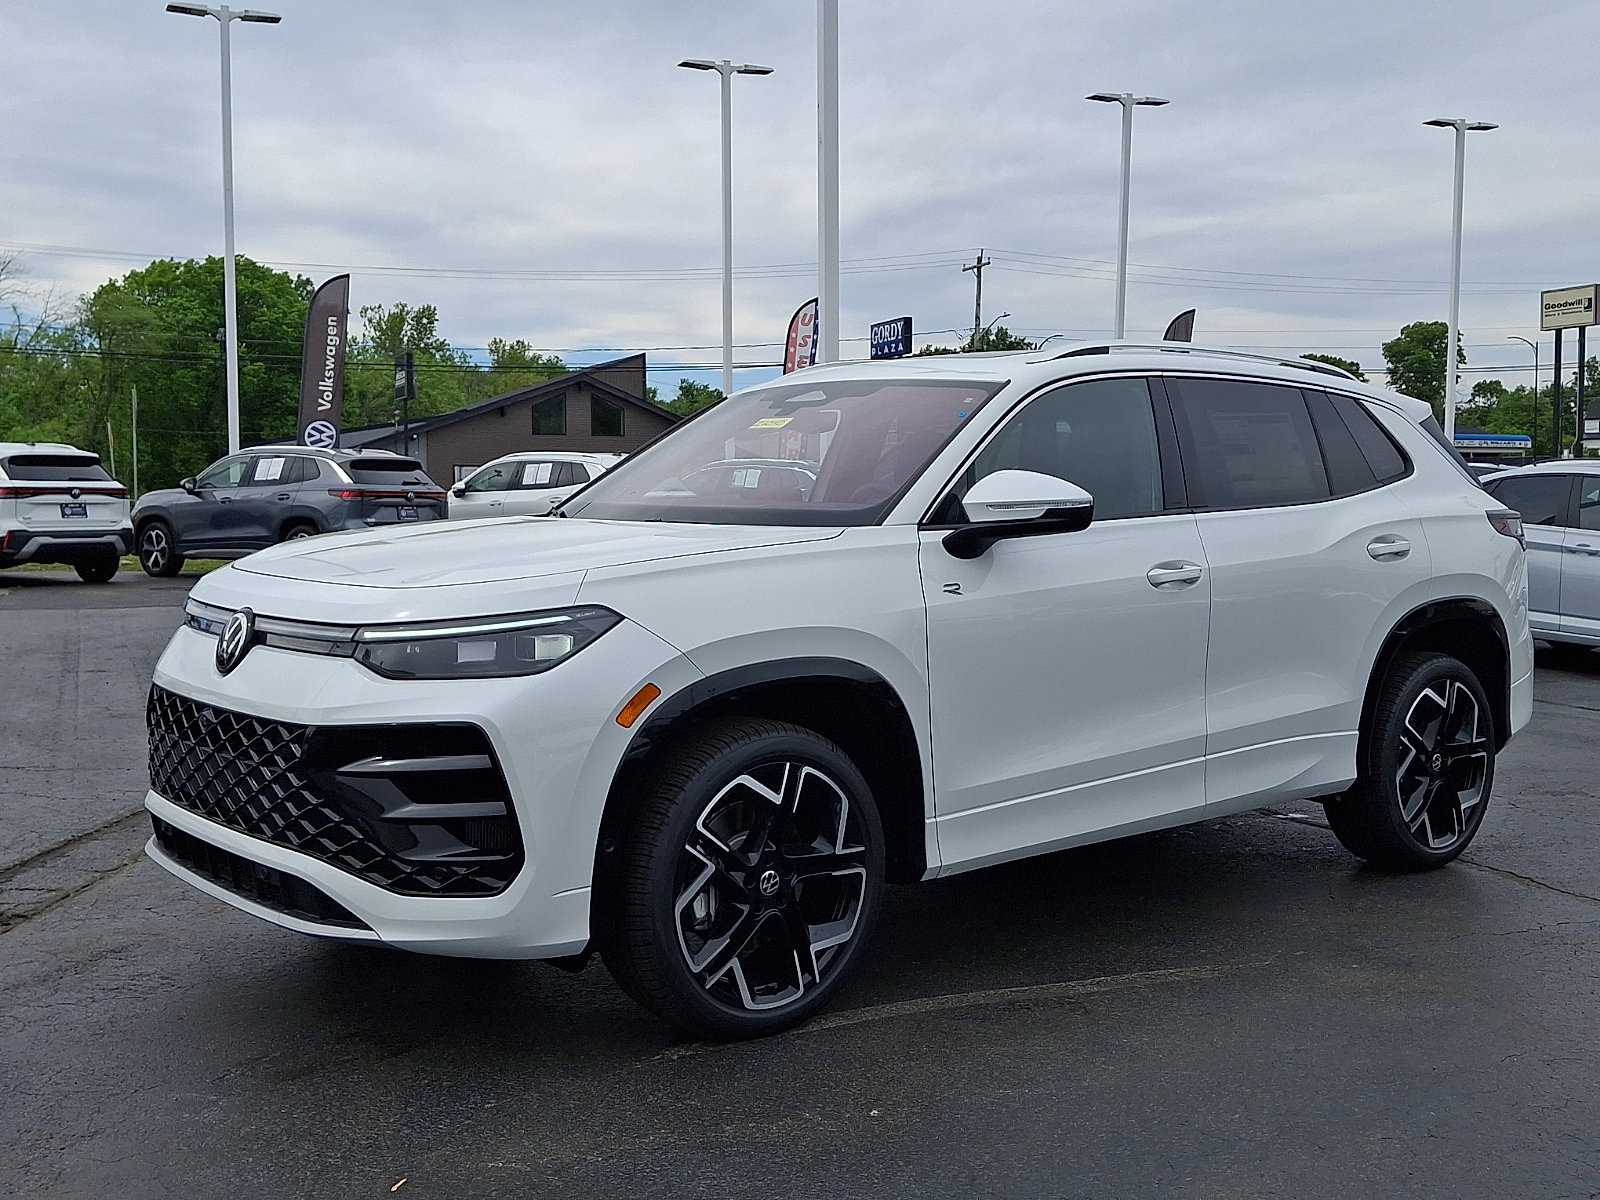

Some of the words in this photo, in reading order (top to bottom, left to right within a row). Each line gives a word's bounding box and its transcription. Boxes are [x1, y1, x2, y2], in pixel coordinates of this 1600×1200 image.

[1544, 298, 1583, 310] Goodwill
[871, 321, 904, 345] GORDY
[871, 343, 904, 357] PLAZA
[317, 316, 339, 412] Volkswagen
